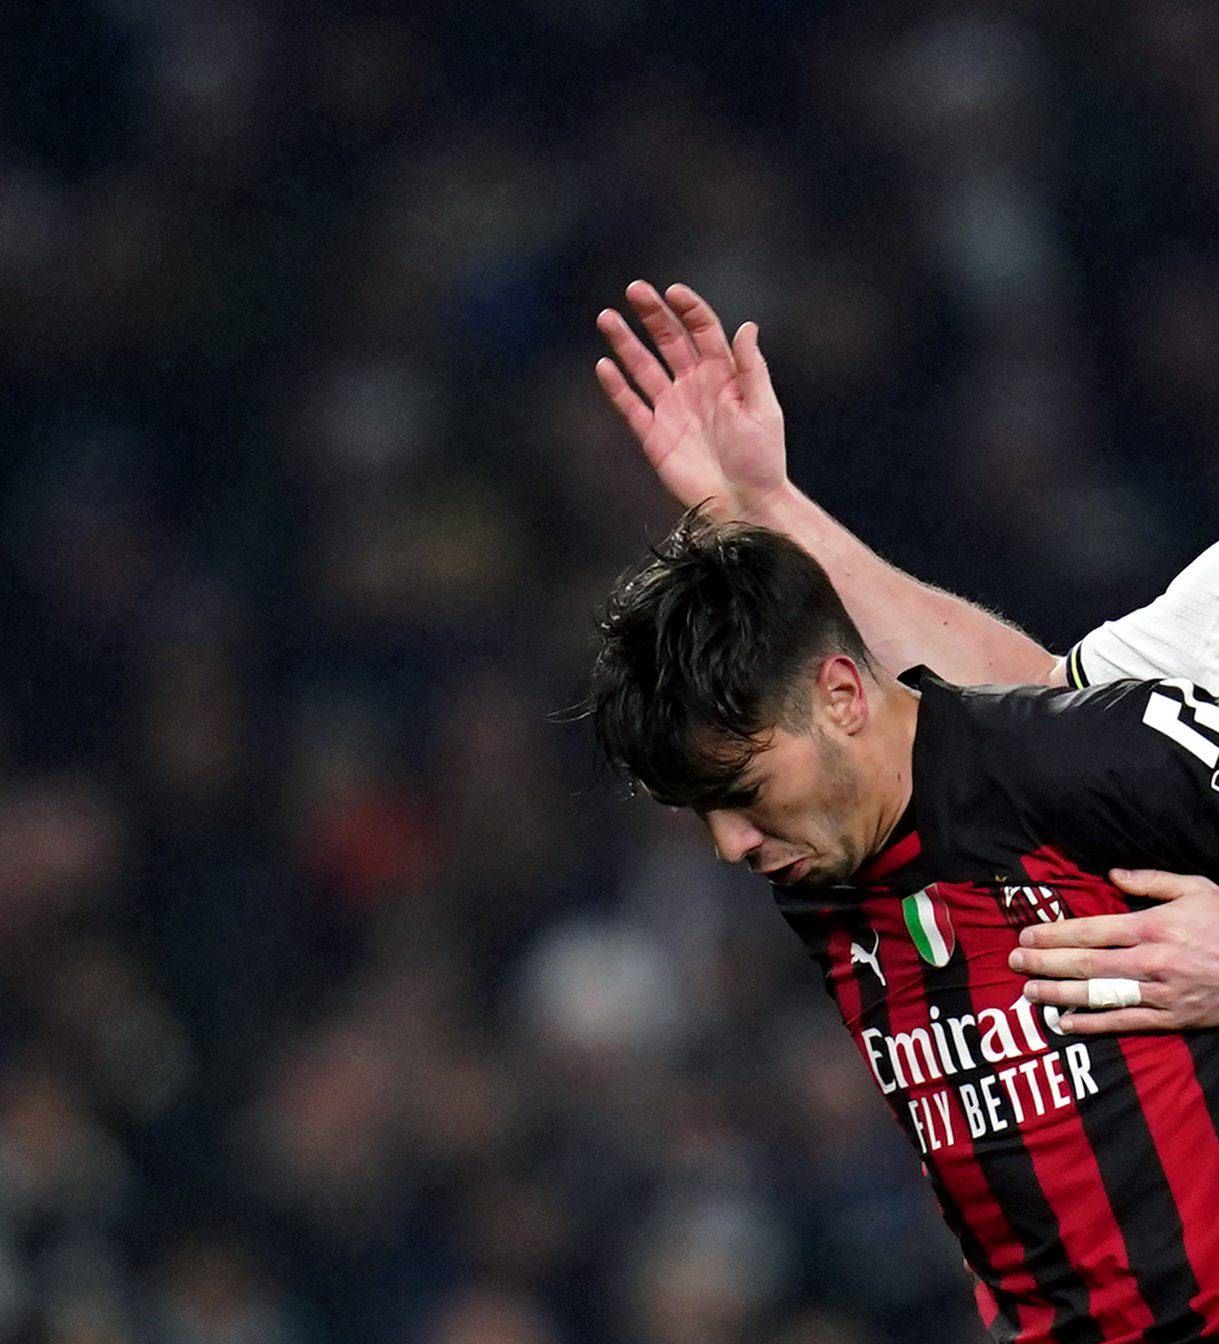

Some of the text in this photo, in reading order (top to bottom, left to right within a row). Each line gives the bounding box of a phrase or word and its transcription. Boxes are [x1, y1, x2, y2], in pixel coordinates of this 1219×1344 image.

[861, 994, 1066, 1095] Emirat
[908, 1043, 1099, 1154] FLY BETTER
